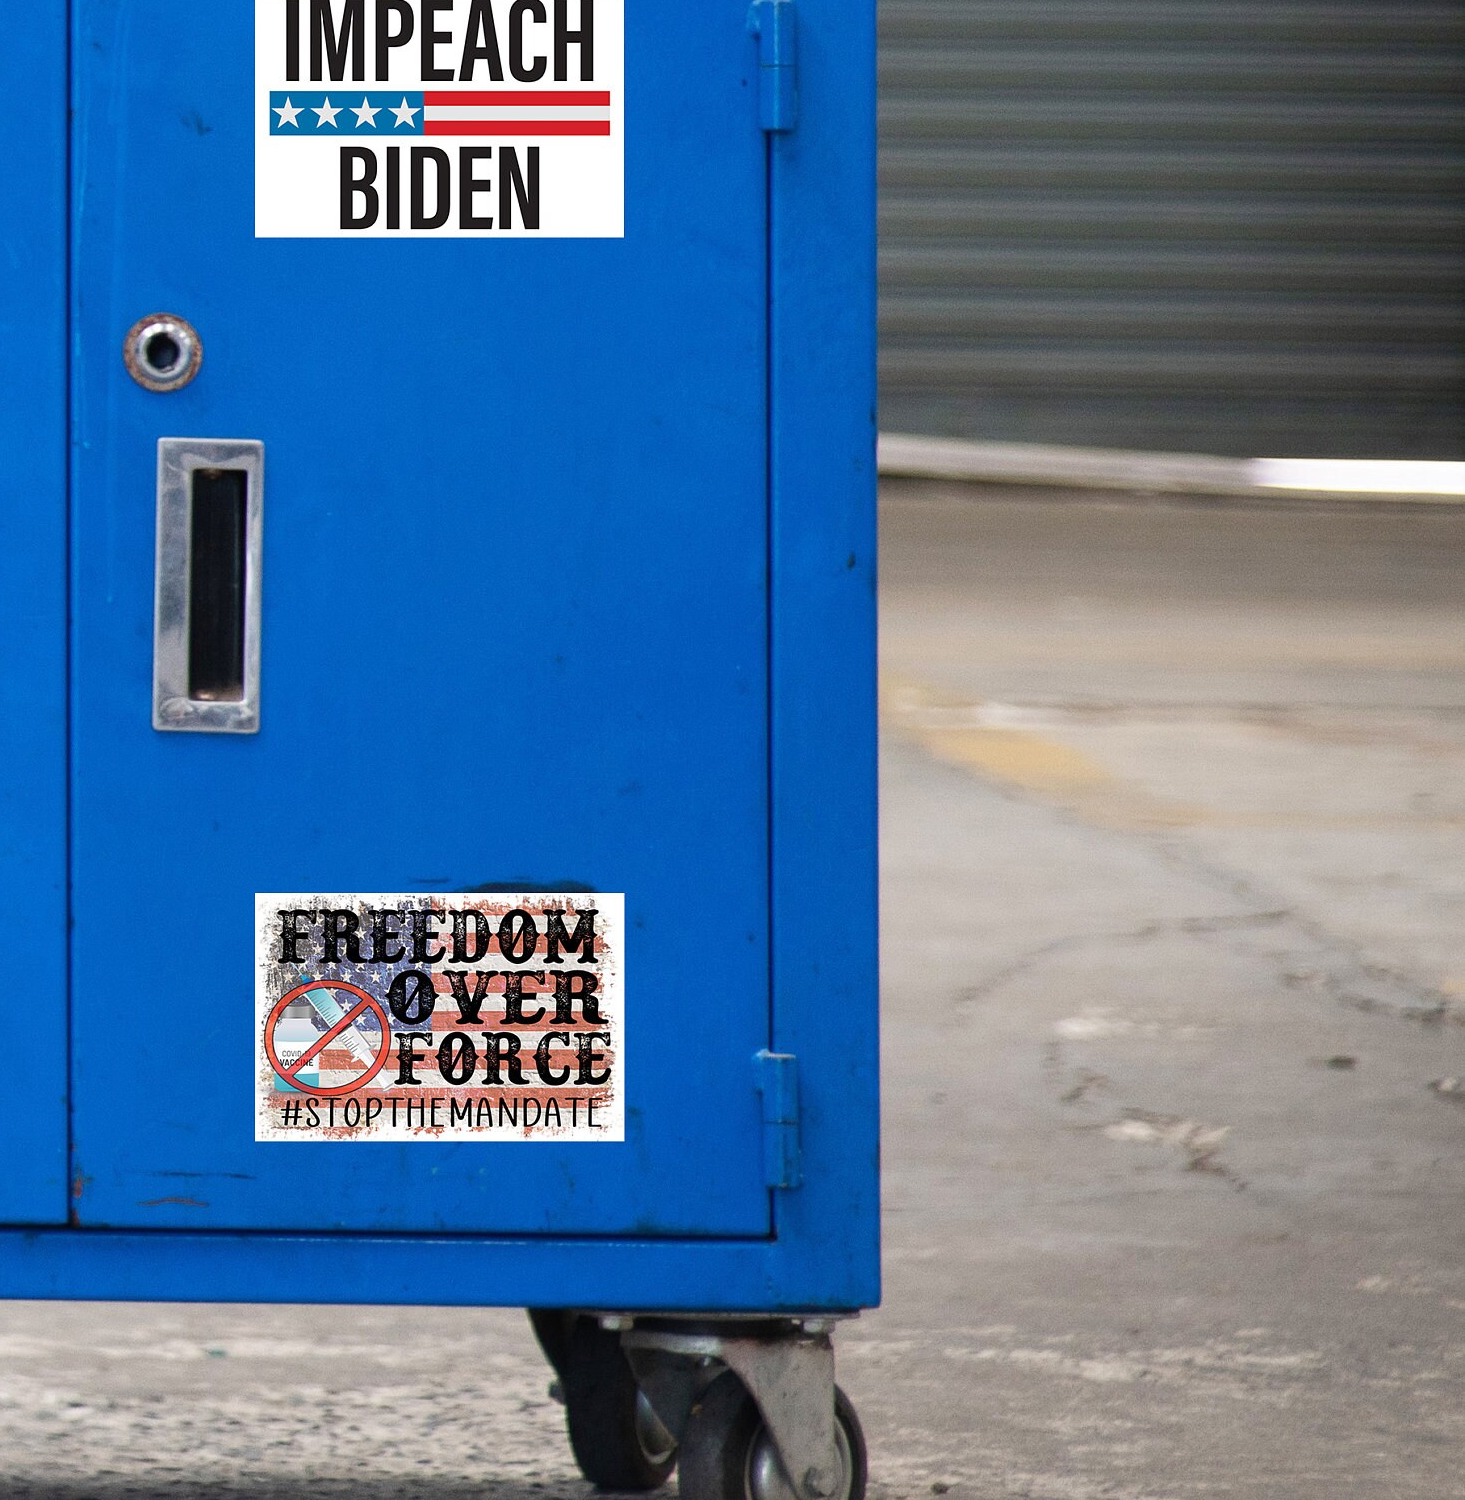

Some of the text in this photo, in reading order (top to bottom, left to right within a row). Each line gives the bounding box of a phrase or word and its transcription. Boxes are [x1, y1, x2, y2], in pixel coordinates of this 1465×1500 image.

[339, 146, 540, 230] BIDEN
[276, 908, 599, 964] FREEDOM
[385, 969, 609, 1026] OVER
[393, 1031, 612, 1086] FORCE
[280, 1097, 603, 1128] #STOPTHEMANDATE
